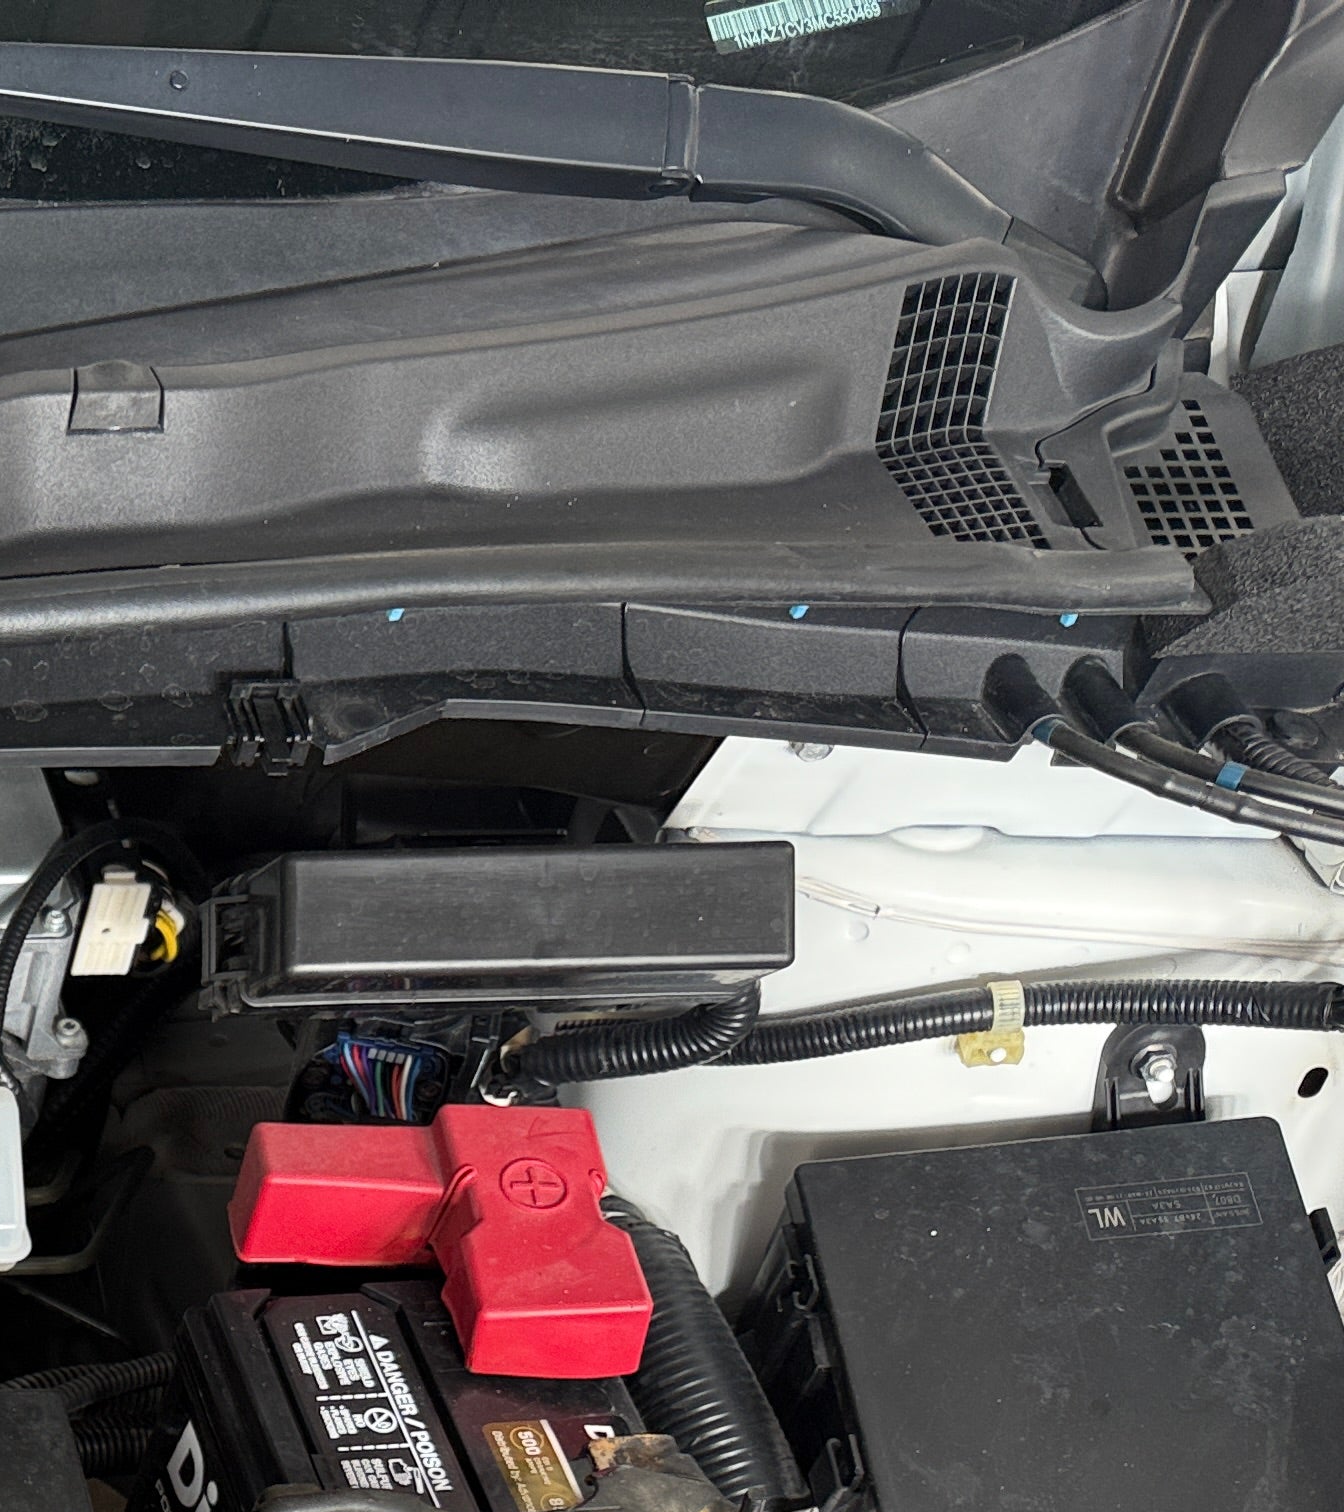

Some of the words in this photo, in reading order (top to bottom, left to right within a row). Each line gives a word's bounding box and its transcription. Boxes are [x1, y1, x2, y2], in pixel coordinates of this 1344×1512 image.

[733, 3, 881, 50] 1N4AZ1CV3MC550469
[1087, 1205, 1126, 1229] WL
[375, 1347, 418, 1417] DANGER
[410, 1426, 453, 1495] POISON
[517, 1428, 541, 1458] 500
